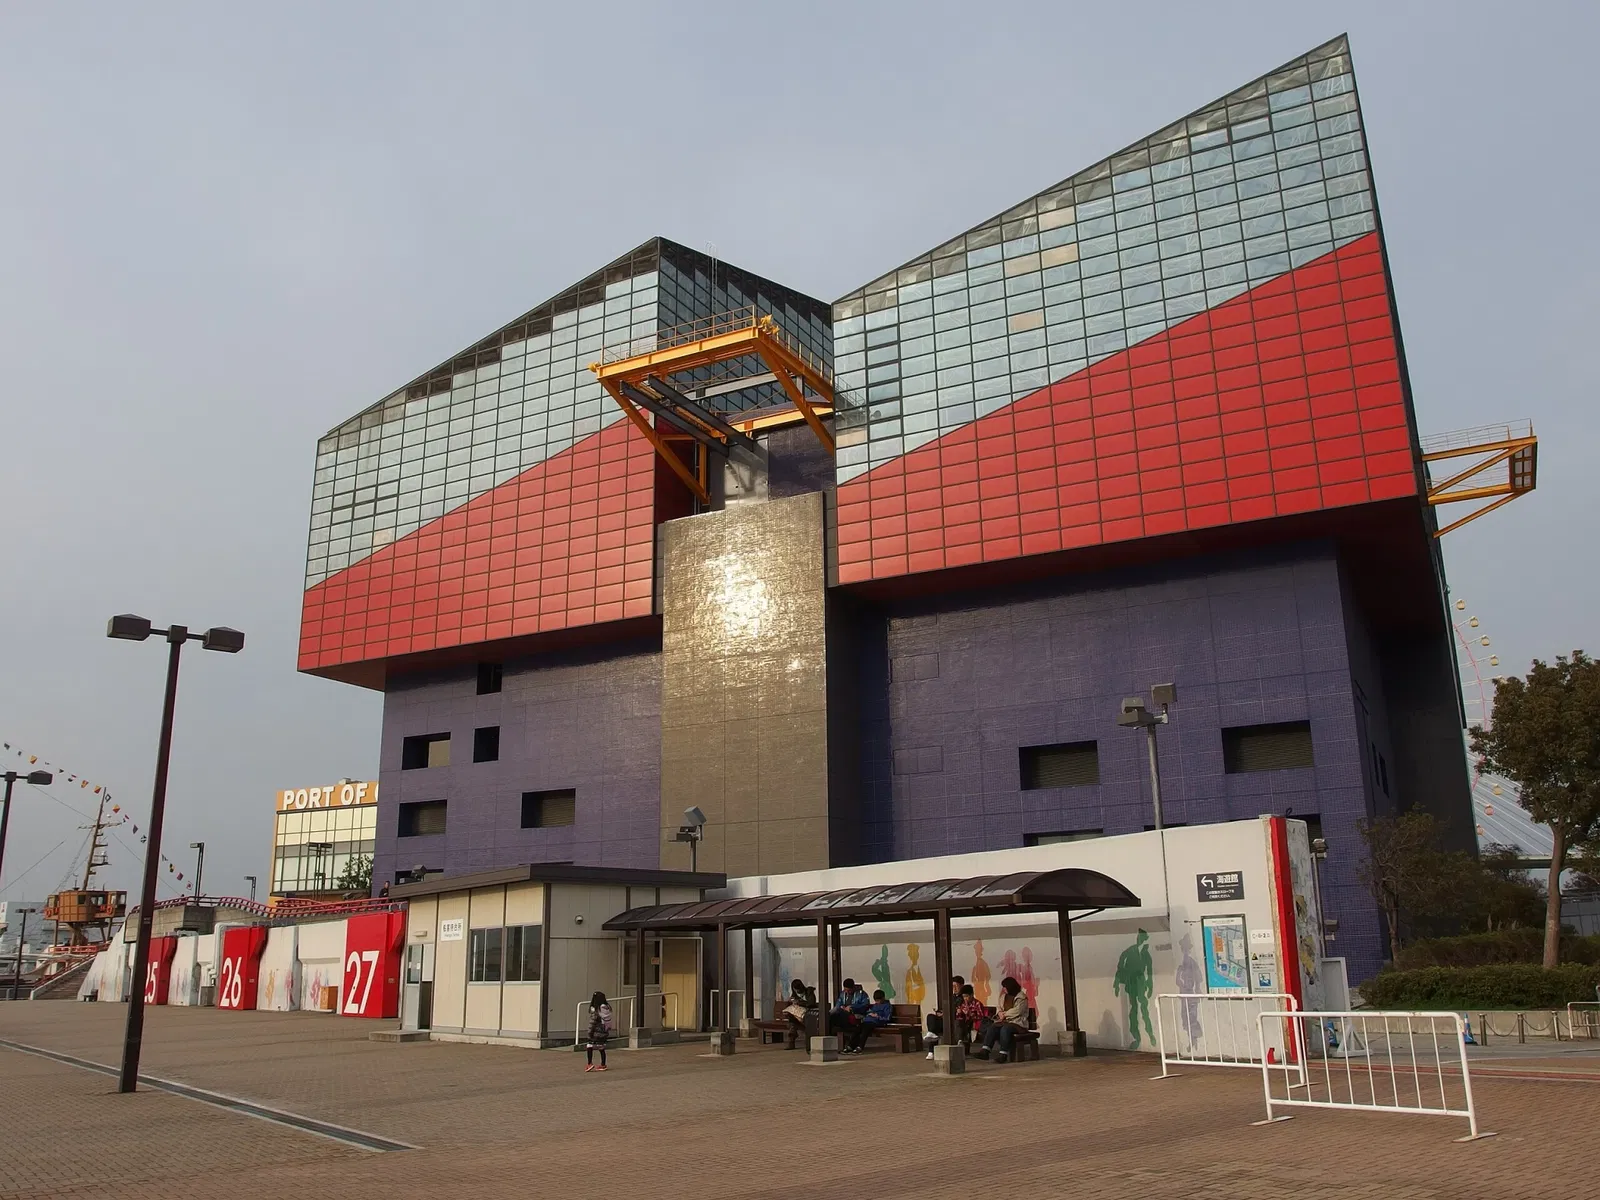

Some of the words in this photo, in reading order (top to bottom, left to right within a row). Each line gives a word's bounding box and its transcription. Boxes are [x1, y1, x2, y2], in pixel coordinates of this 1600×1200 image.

[283, 786, 334, 810] PORT
[341, 783, 368, 805] OF
[219, 956, 242, 1007] 26
[343, 950, 380, 1014] 27
